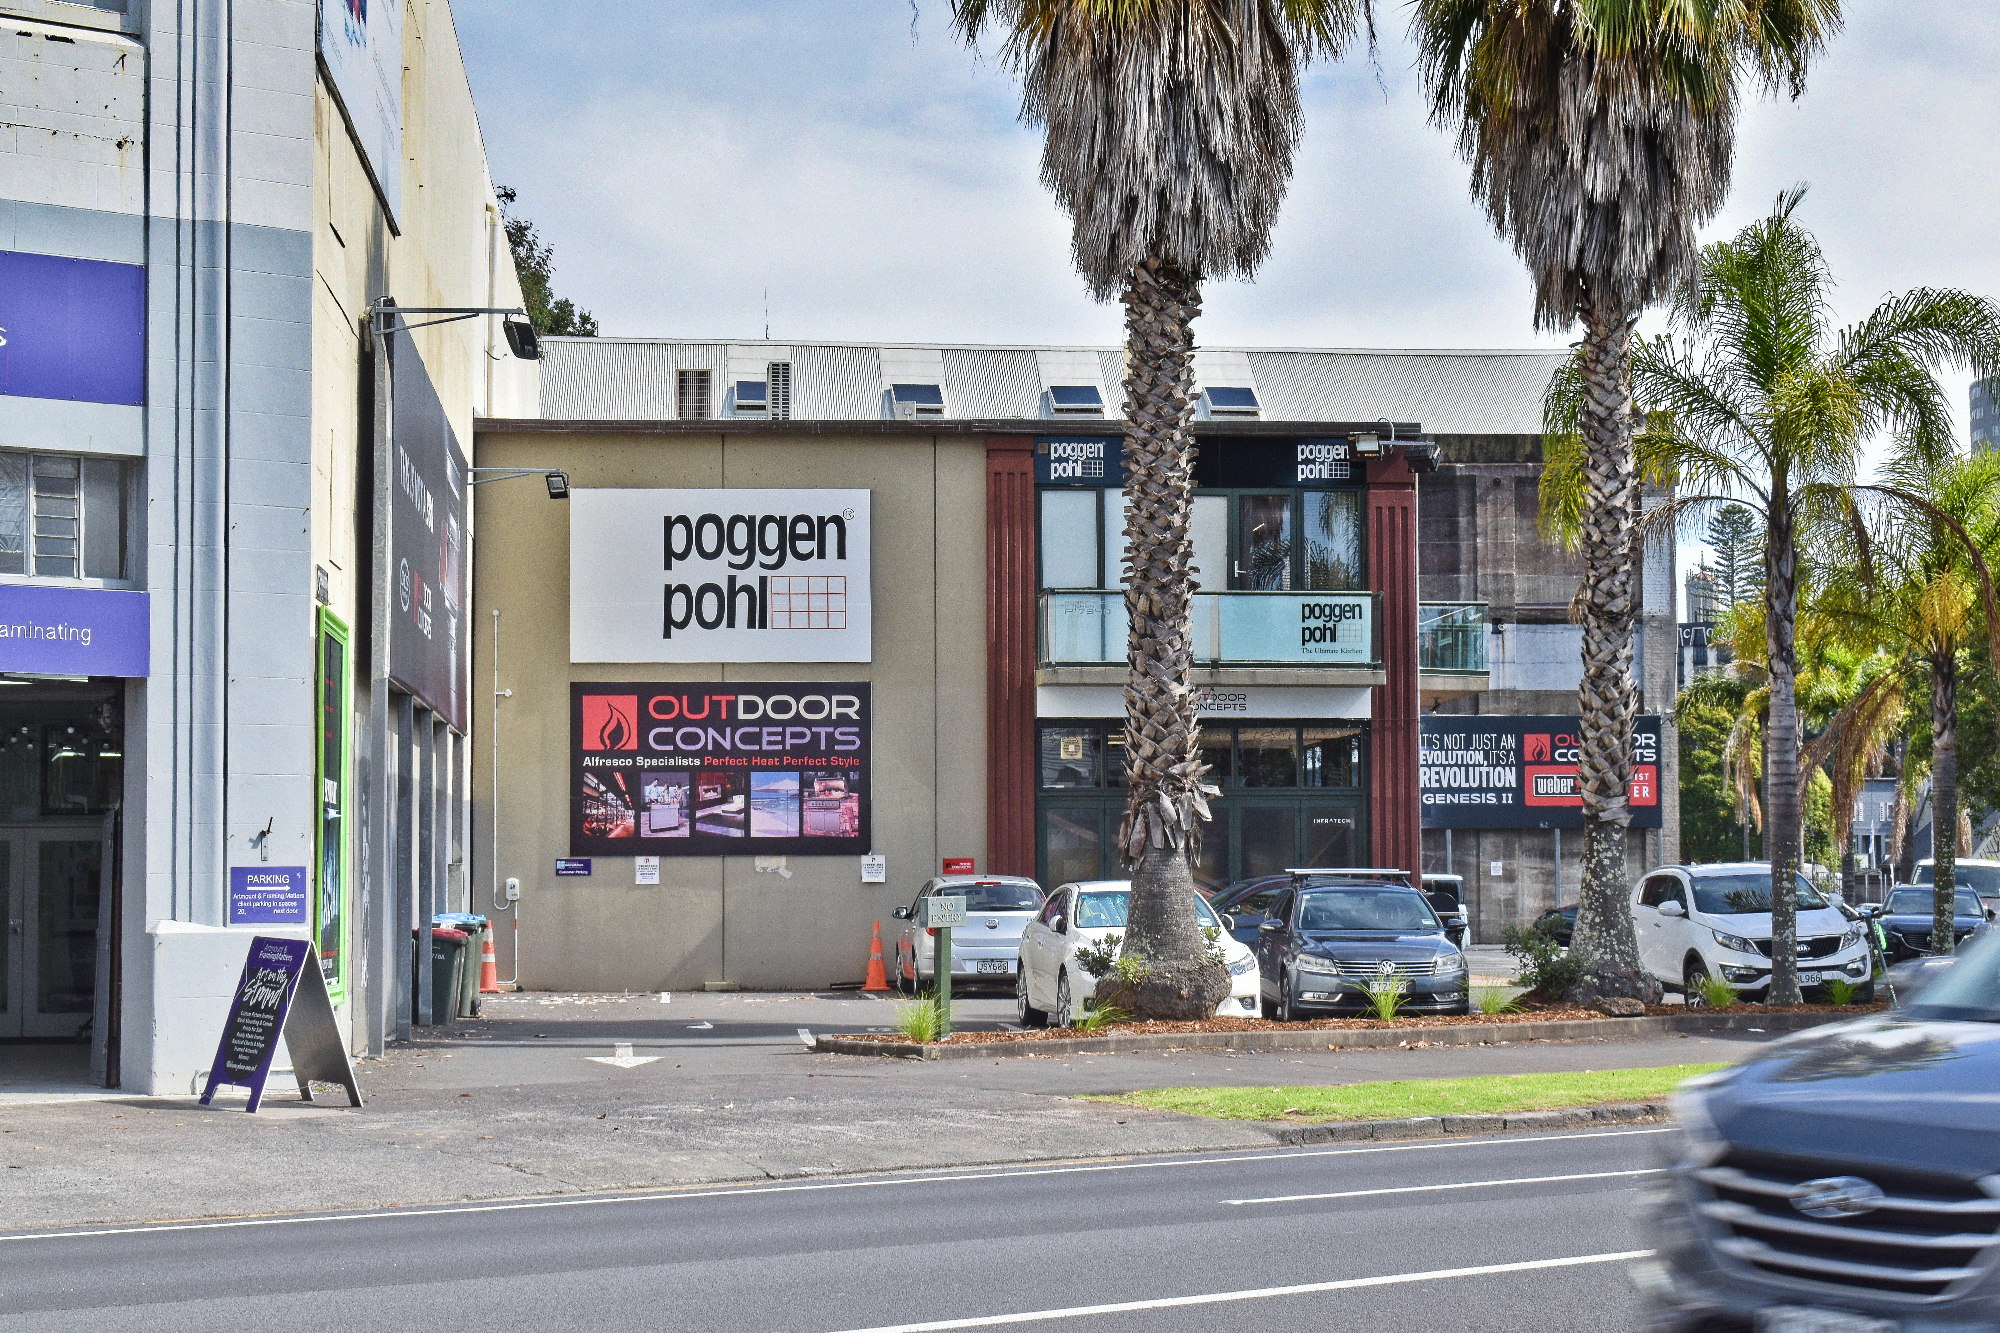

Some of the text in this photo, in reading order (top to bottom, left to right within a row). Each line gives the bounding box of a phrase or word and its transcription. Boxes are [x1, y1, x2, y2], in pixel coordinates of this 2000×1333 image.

[1050, 442, 1104, 460] poggen
[1297, 444, 1350, 462] poggen
[1050, 460, 1082, 480] pohl
[1297, 462, 1328, 482] pohl
[662, 574, 769, 640] pohl
[1301, 603, 1363, 623] poggen
[0, 620, 91, 646] aminating
[1301, 623, 1337, 647] pohl
[648, 695, 860, 720] OUTDOOR
[648, 726, 860, 750] CONCEPTS
[1443, 733, 1466, 750] NOT
[1469, 733, 1498, 750] JUST
[1500, 733, 1516, 750] AN
[583, 755, 860, 769] Alfresco Specialists Perfect Heat Perfect Style
[1420, 750, 1516, 767] EVOLUTION, IT'S A
[1420, 766, 1517, 788] REVOLUTION
[1537, 775, 1574, 794] weber
[1422, 793, 1513, 805] GENESIS II
[247, 874, 290, 884] PARKING
[262, 892, 285, 900] Framing
[940, 902, 955, 911] NO
[931, 913, 962, 923] ENTRY
